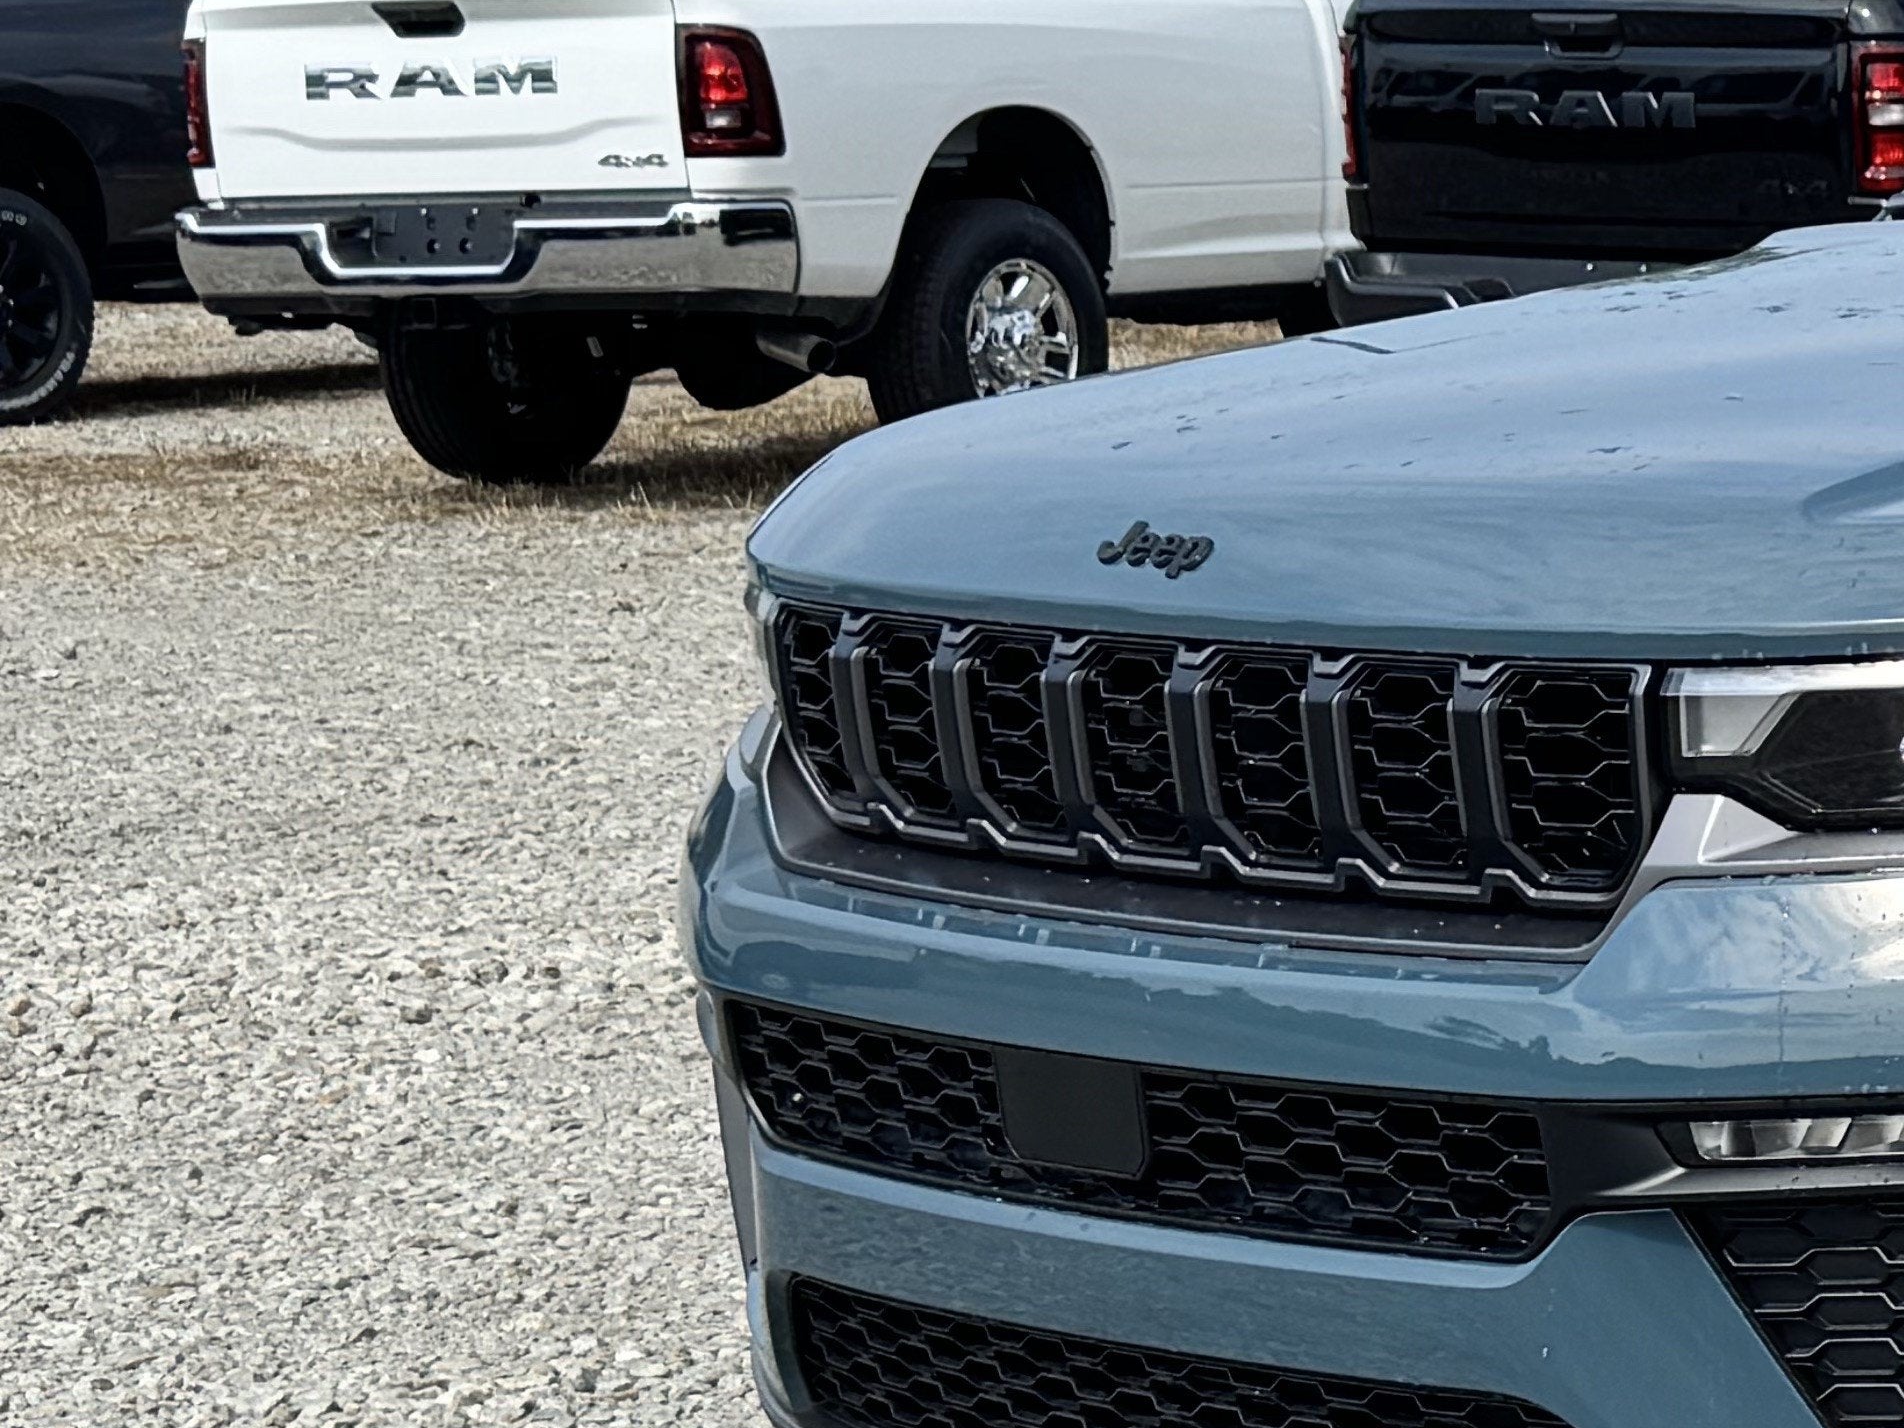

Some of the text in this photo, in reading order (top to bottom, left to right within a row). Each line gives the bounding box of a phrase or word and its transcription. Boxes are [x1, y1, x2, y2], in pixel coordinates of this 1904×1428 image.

[304, 55, 559, 101] RAM
[1475, 88, 1696, 128] RAM
[1097, 521, 1214, 579] Jeep
